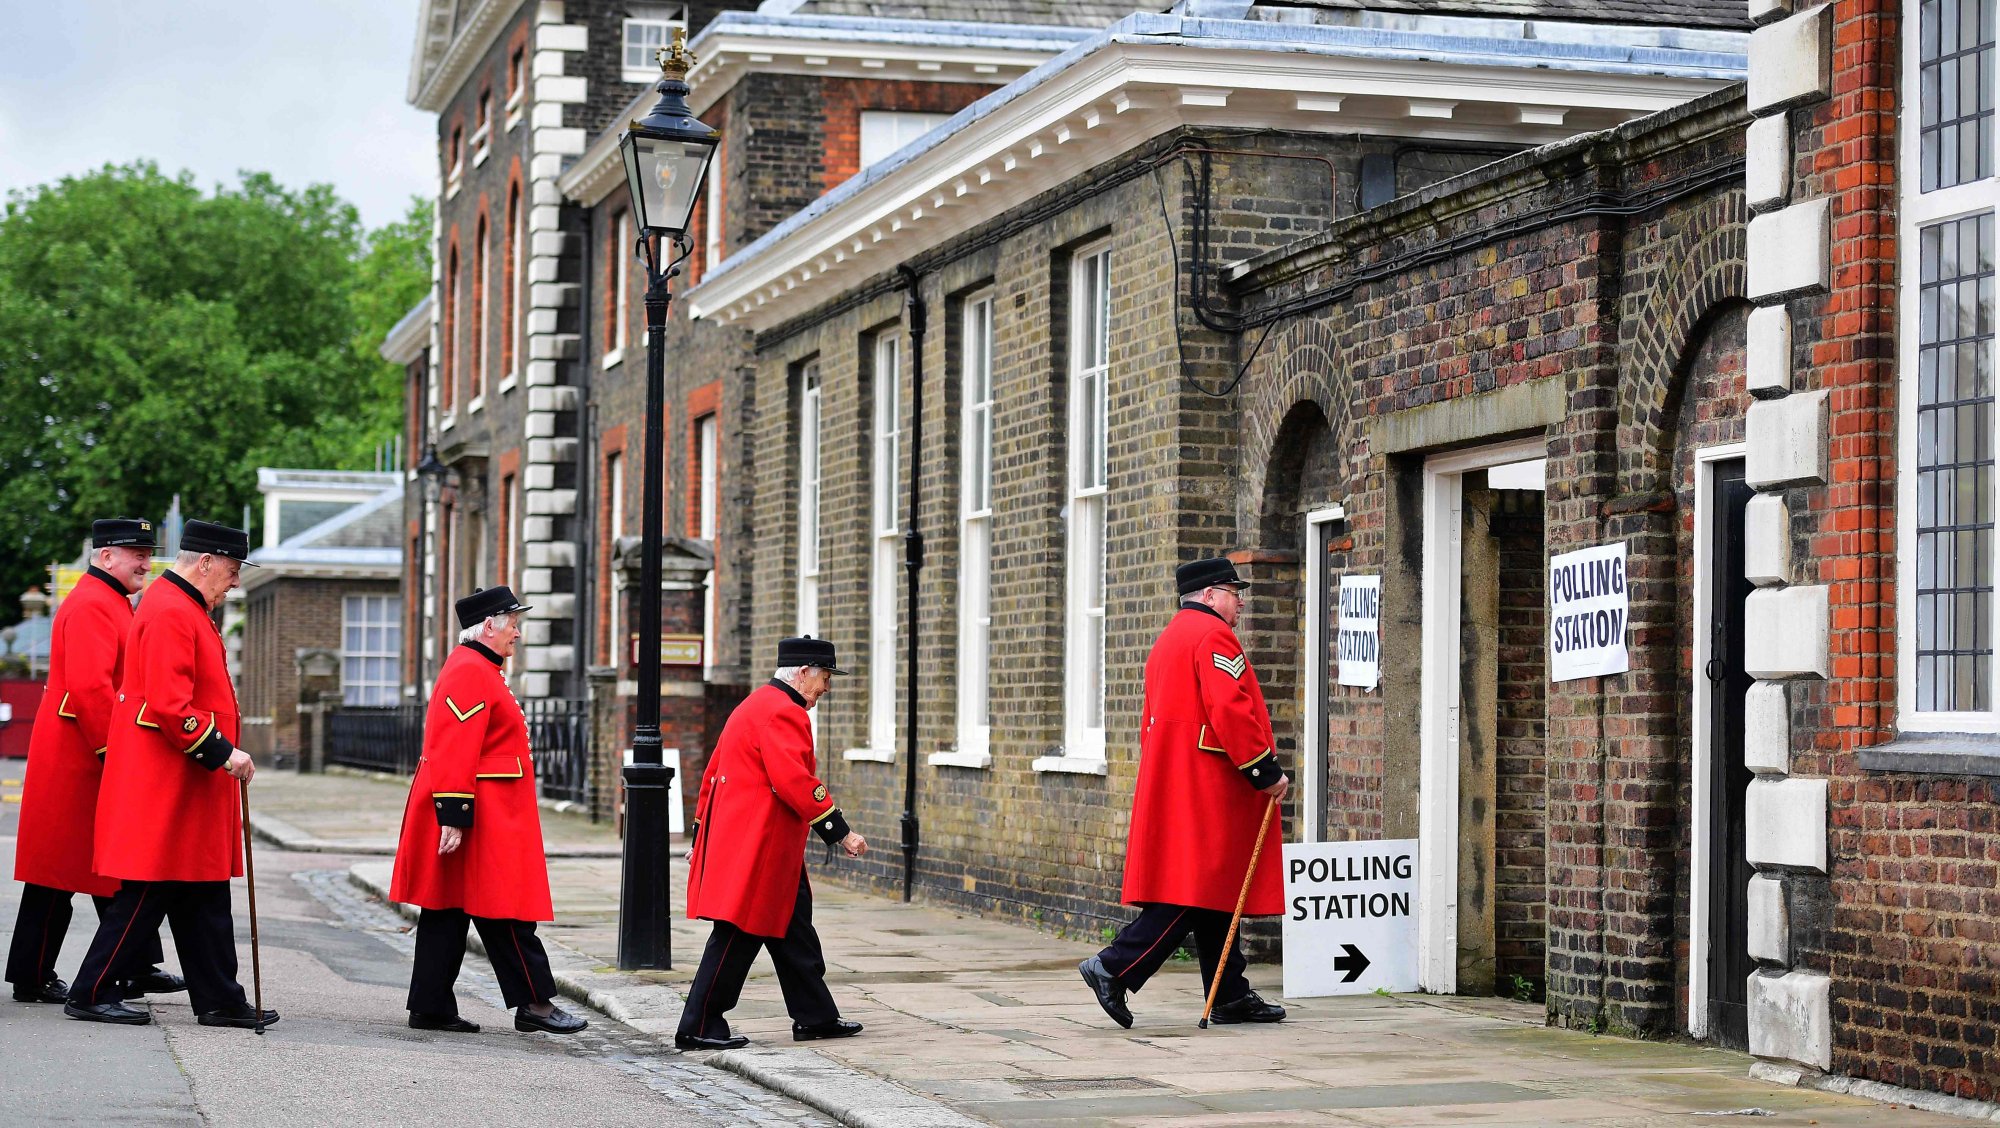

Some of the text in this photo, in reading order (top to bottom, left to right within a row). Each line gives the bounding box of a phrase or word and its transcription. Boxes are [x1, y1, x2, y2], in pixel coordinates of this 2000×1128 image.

[1553, 556, 1624, 604] POLLING
[1340, 587, 1377, 619] POLLING
[1339, 630, 1376, 662] STATION
[1554, 608, 1623, 653] STATION
[1290, 855, 1412, 883] POLLING
[1292, 892, 1410, 921] STATION
